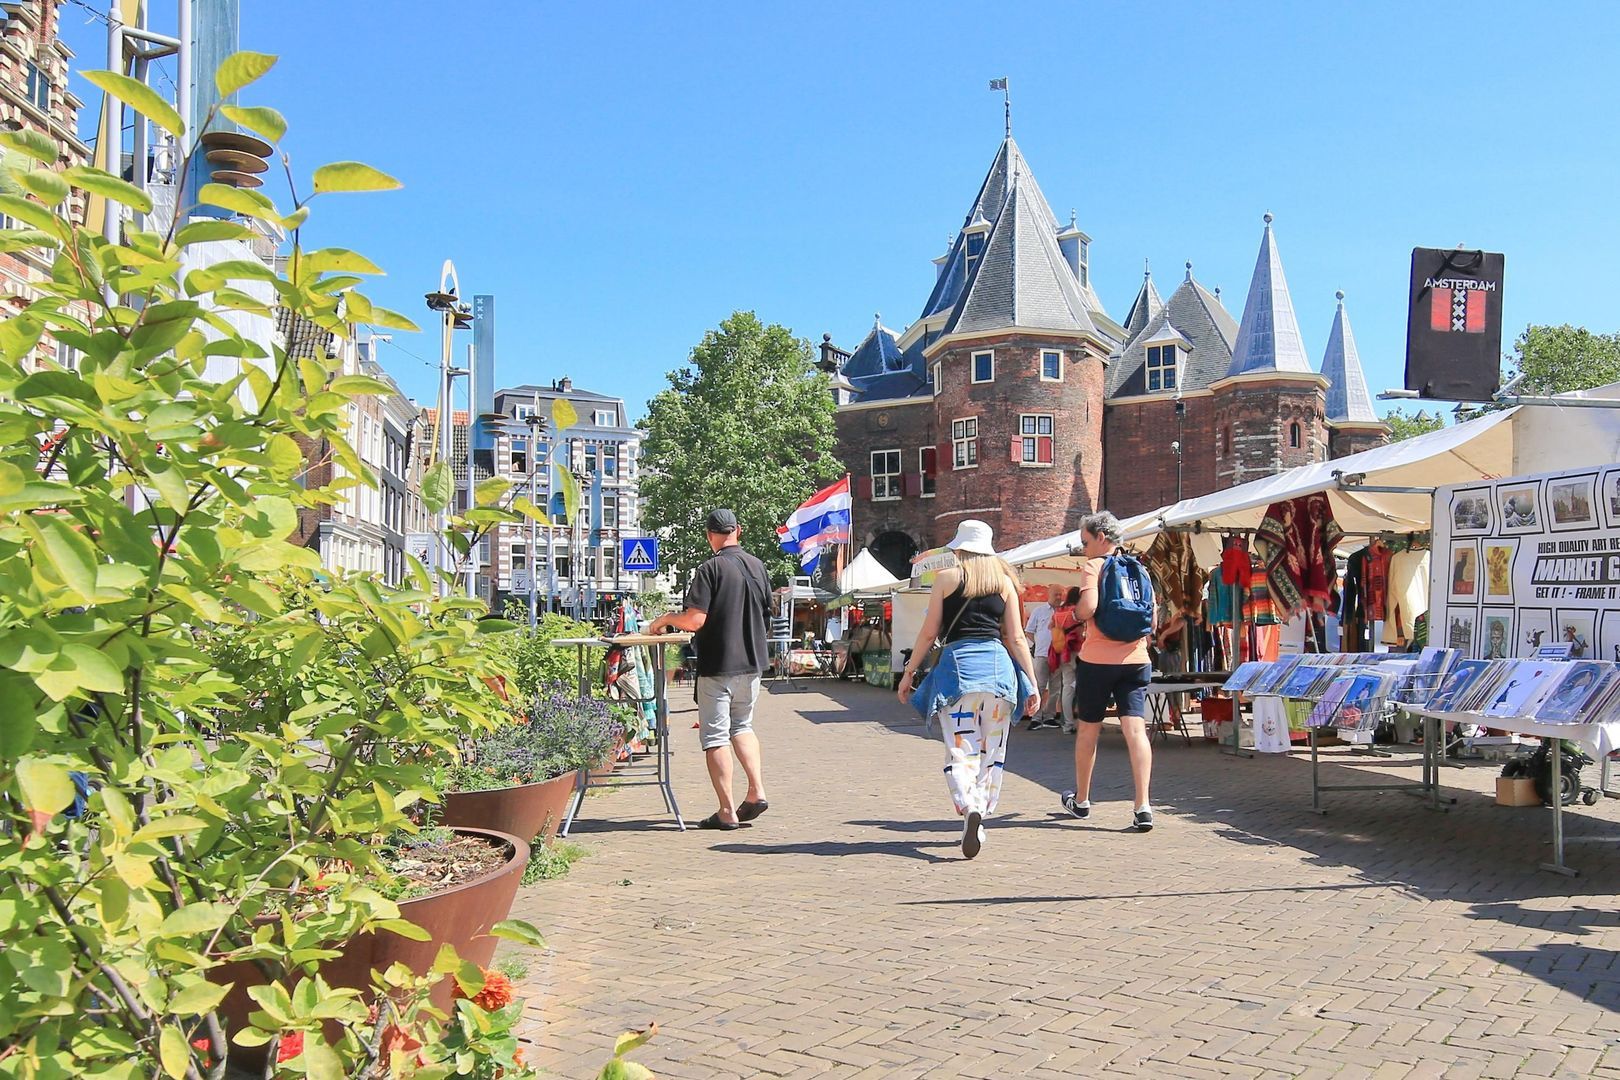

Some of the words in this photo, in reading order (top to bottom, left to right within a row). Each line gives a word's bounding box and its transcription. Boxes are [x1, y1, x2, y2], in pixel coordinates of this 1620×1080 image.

[1424, 277, 1496, 292] AMSTERDAM
[1538, 542, 1556, 554] HIGH
[1559, 540, 1589, 553] QUALITY
[1592, 538, 1607, 551] ART
[1534, 557, 1603, 580] MARKET
[1536, 587, 1550, 598] GET
[1575, 587, 1606, 599] FRAME
[1608, 587, 1616, 599] IT
